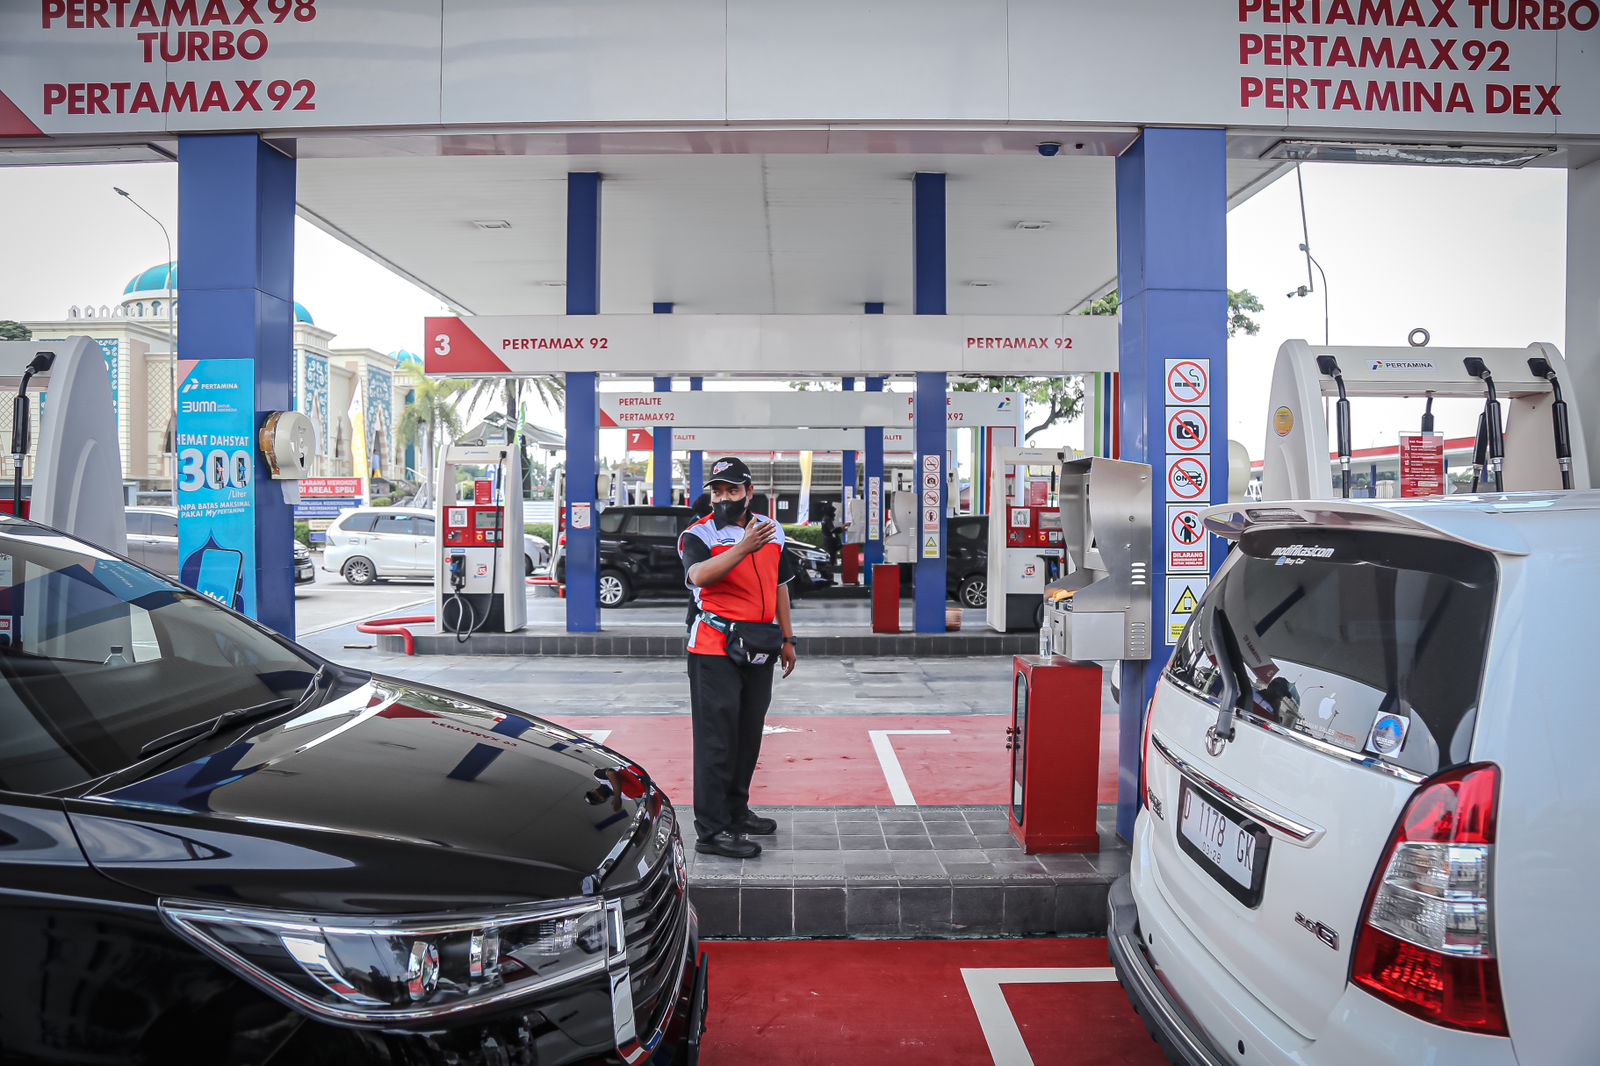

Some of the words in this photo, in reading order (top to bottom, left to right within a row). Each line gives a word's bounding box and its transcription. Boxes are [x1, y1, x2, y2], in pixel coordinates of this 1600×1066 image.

[1238, 0, 1458, 28] PERTAMAX
[1468, 0, 1600, 31] TURBO
[137, 29, 269, 63] TURBO
[1240, 76, 1475, 113] PERTAMINA
[1485, 83, 1562, 116] DEX
[434, 333, 451, 356] 3
[502, 338, 585, 350] PERTAMAX
[589, 337, 608, 349] 92
[967, 337, 1049, 349] PERTAMAX
[1054, 337, 1073, 349] 92
[619, 397, 662, 406] PERTALITE
[210, 435, 249, 447] DAHSYAT
[631, 433, 640, 444] 7
[179, 447, 252, 492] 300
[309, 486, 333, 494] AREAL
[335, 486, 356, 494] SPBU
[220, 501, 251, 509] MAKSIMAL
[181, 510, 204, 518] PAKAI
[1184, 789, 1192, 819] D
[1199, 801, 1227, 848] 1178
[1236, 829, 1254, 872] GK
